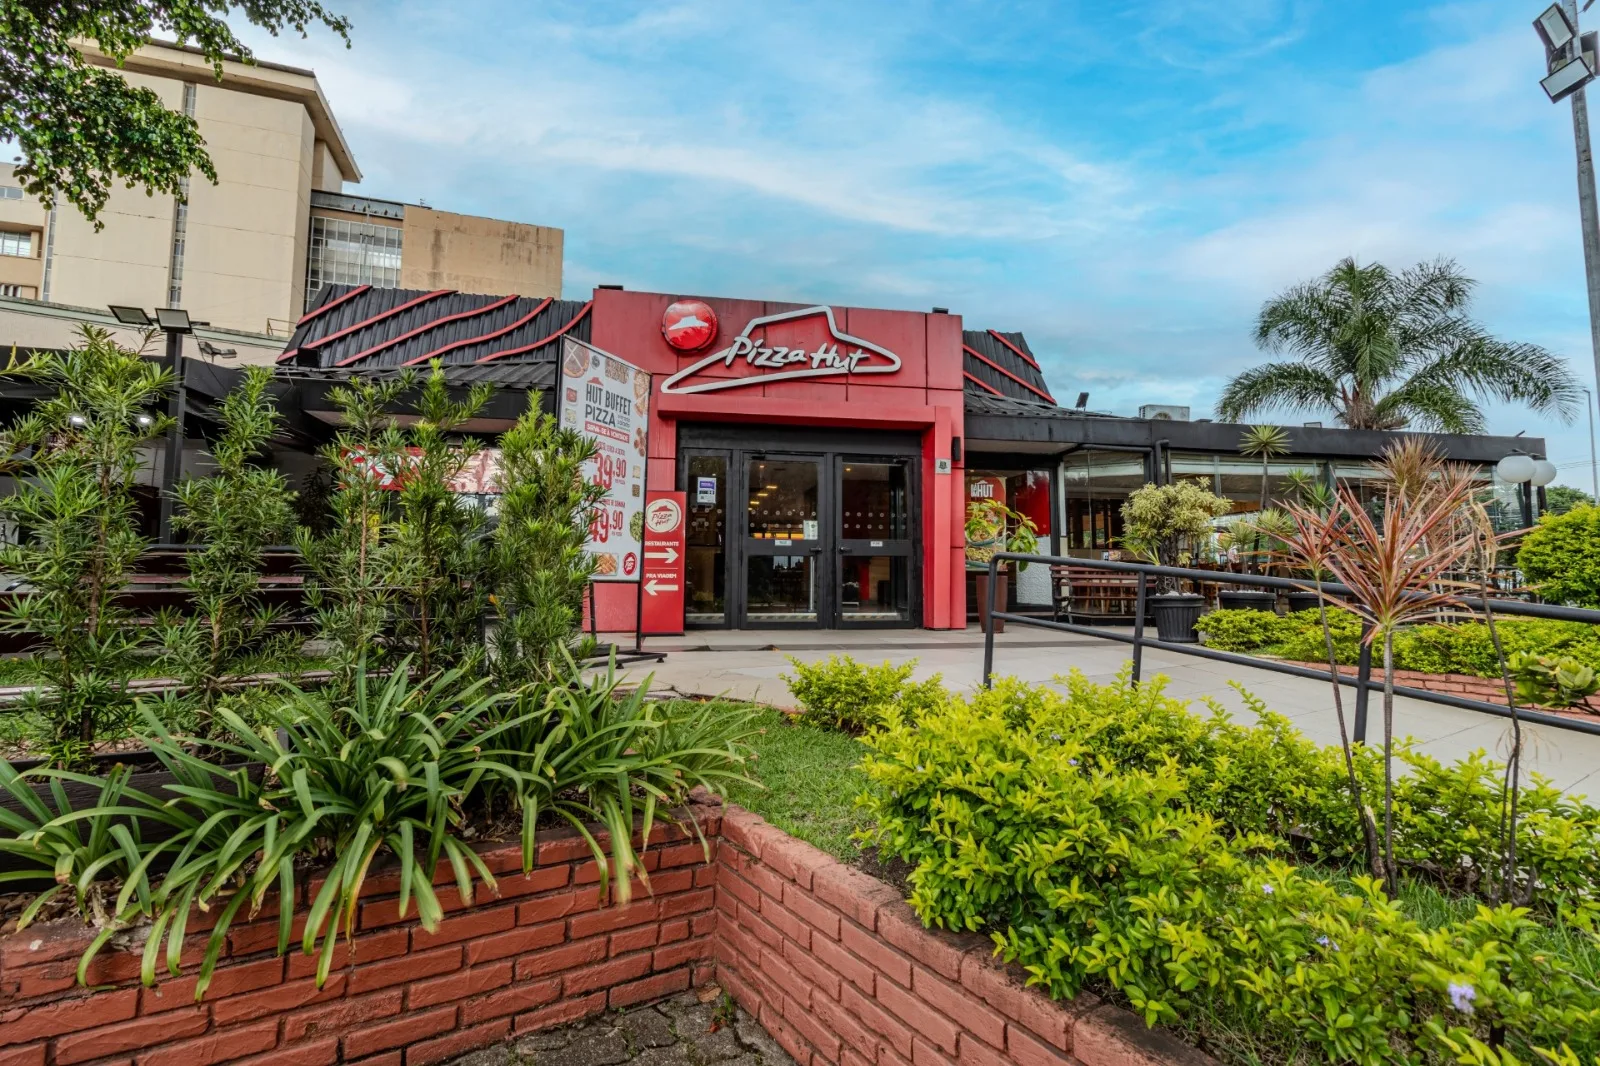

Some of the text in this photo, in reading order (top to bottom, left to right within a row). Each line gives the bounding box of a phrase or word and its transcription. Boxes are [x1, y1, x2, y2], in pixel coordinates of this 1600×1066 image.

[725, 336, 870, 372] Pizza Hut
[585, 404, 616, 427] PIZZA
[586, 384, 631, 416] HUT BUFFET
